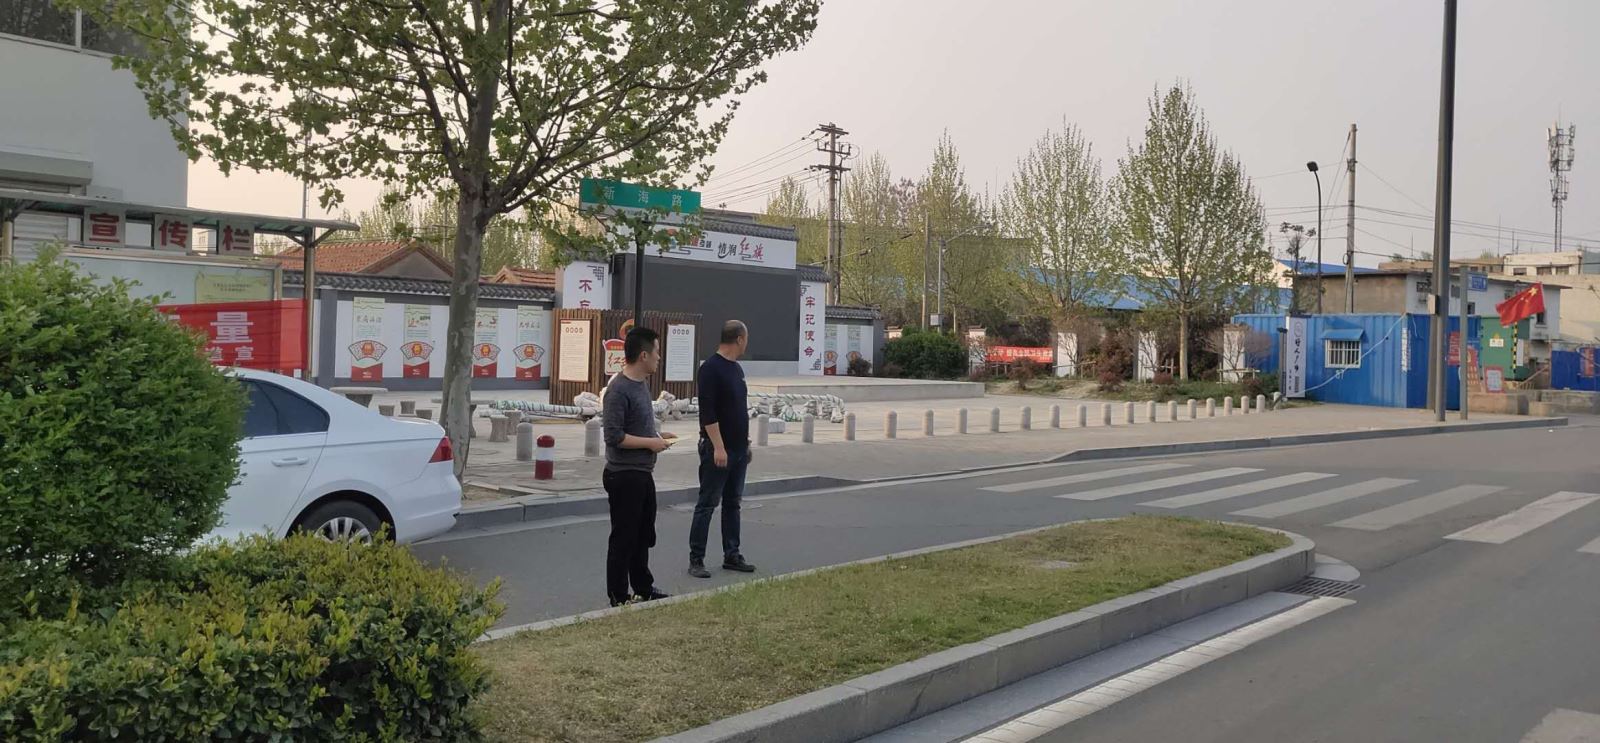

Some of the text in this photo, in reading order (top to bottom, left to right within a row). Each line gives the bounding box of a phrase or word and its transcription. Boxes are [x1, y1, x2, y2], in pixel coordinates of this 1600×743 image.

[603, 186, 682, 206] 新海路
[88, 212, 252, 252] 宣传栏
[804, 296, 816, 356] 牢记使命
